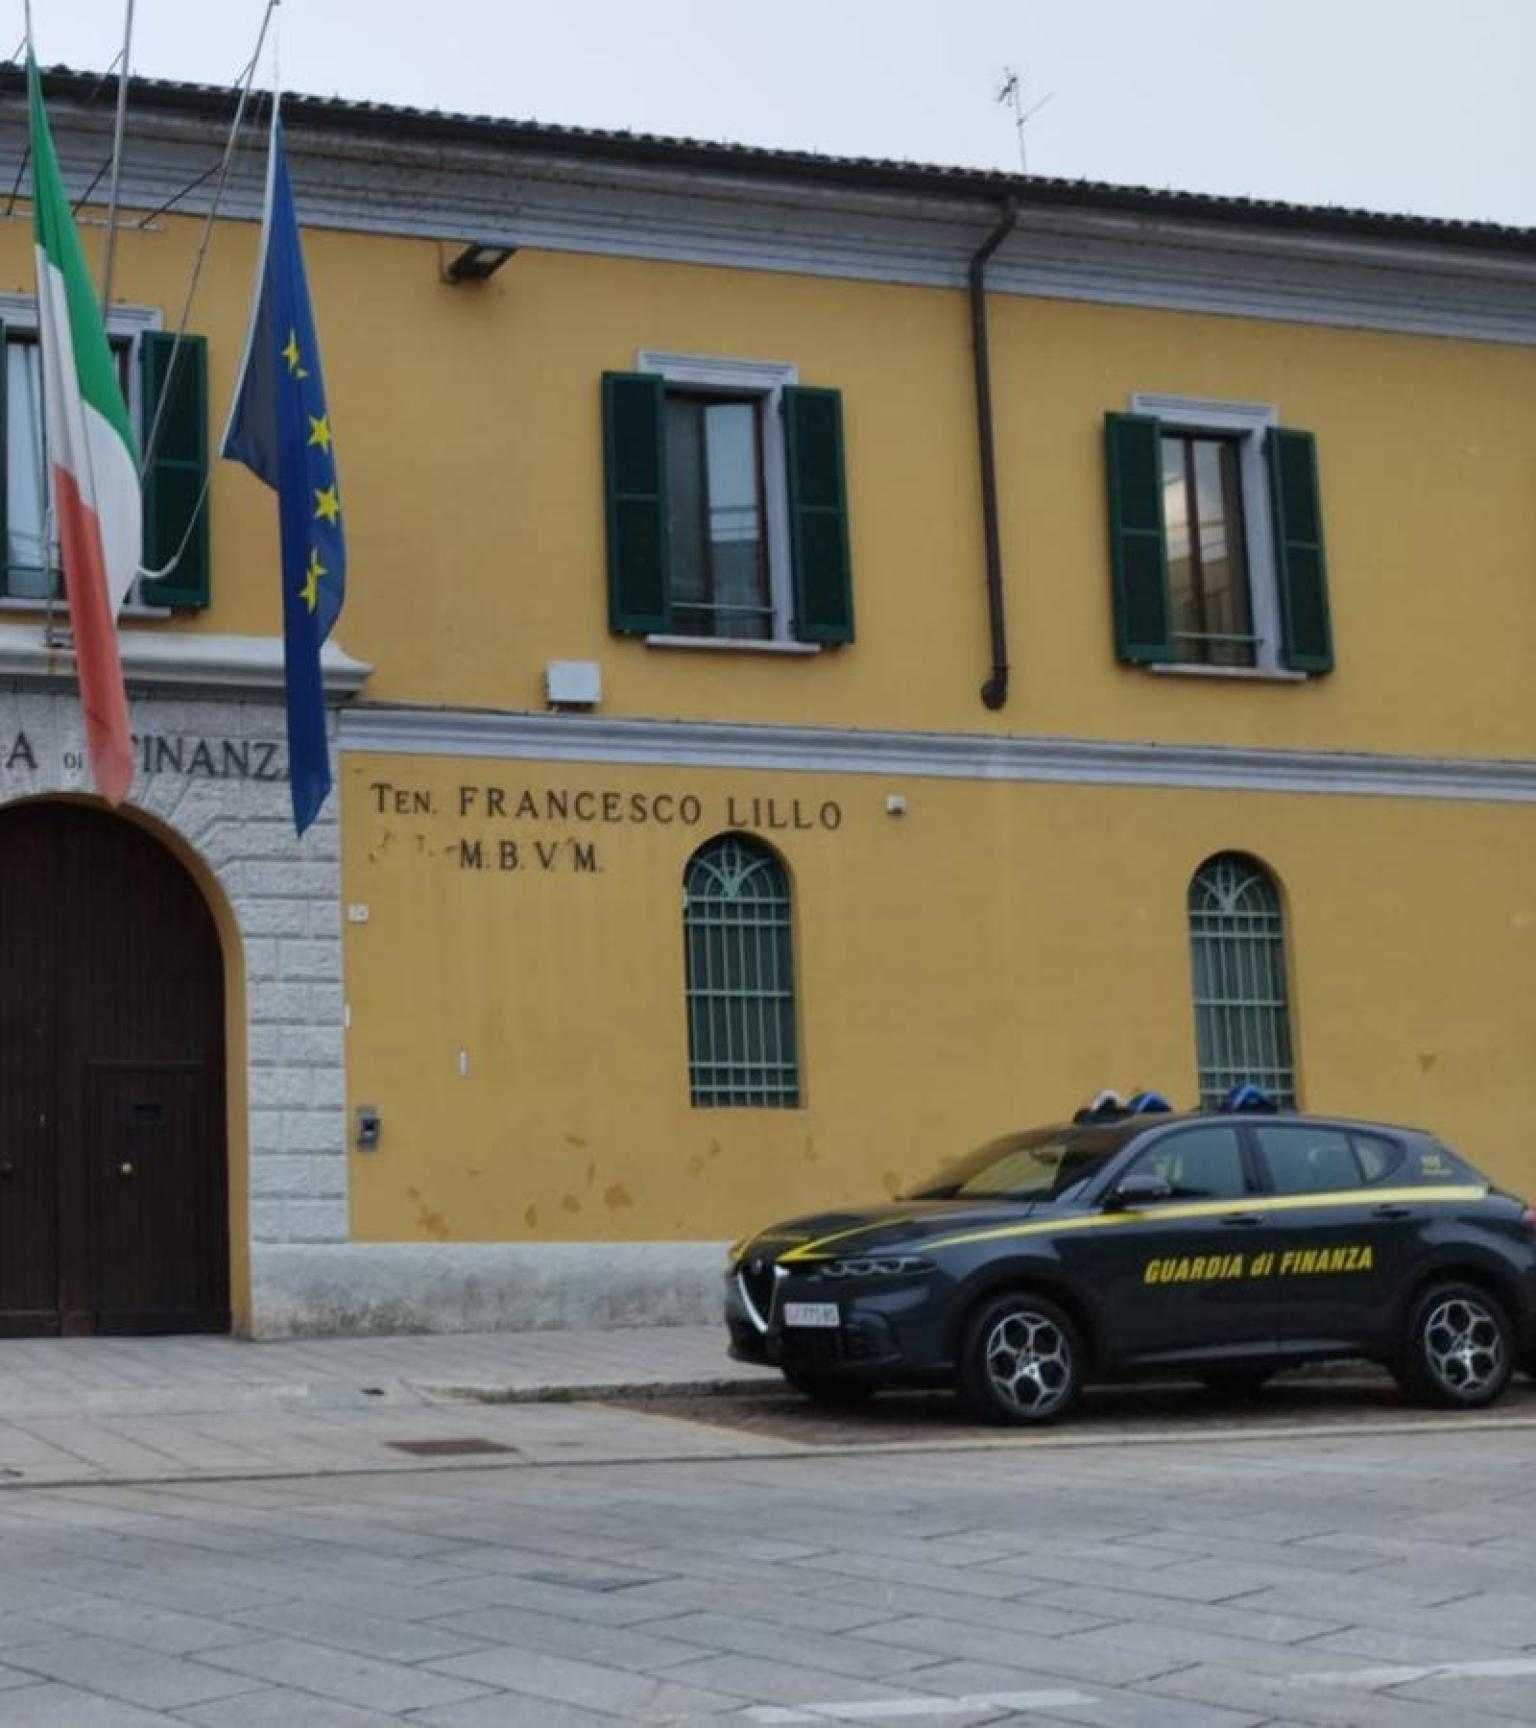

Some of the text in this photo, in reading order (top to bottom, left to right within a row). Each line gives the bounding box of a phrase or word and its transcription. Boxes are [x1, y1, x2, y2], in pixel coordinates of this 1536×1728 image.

[131, 734, 290, 781] INANZ
[460, 786, 702, 824] FRANCESCO
[728, 797, 842, 831] LILLO
[1145, 1245, 1373, 1283] GUARDIA di FINANZA
